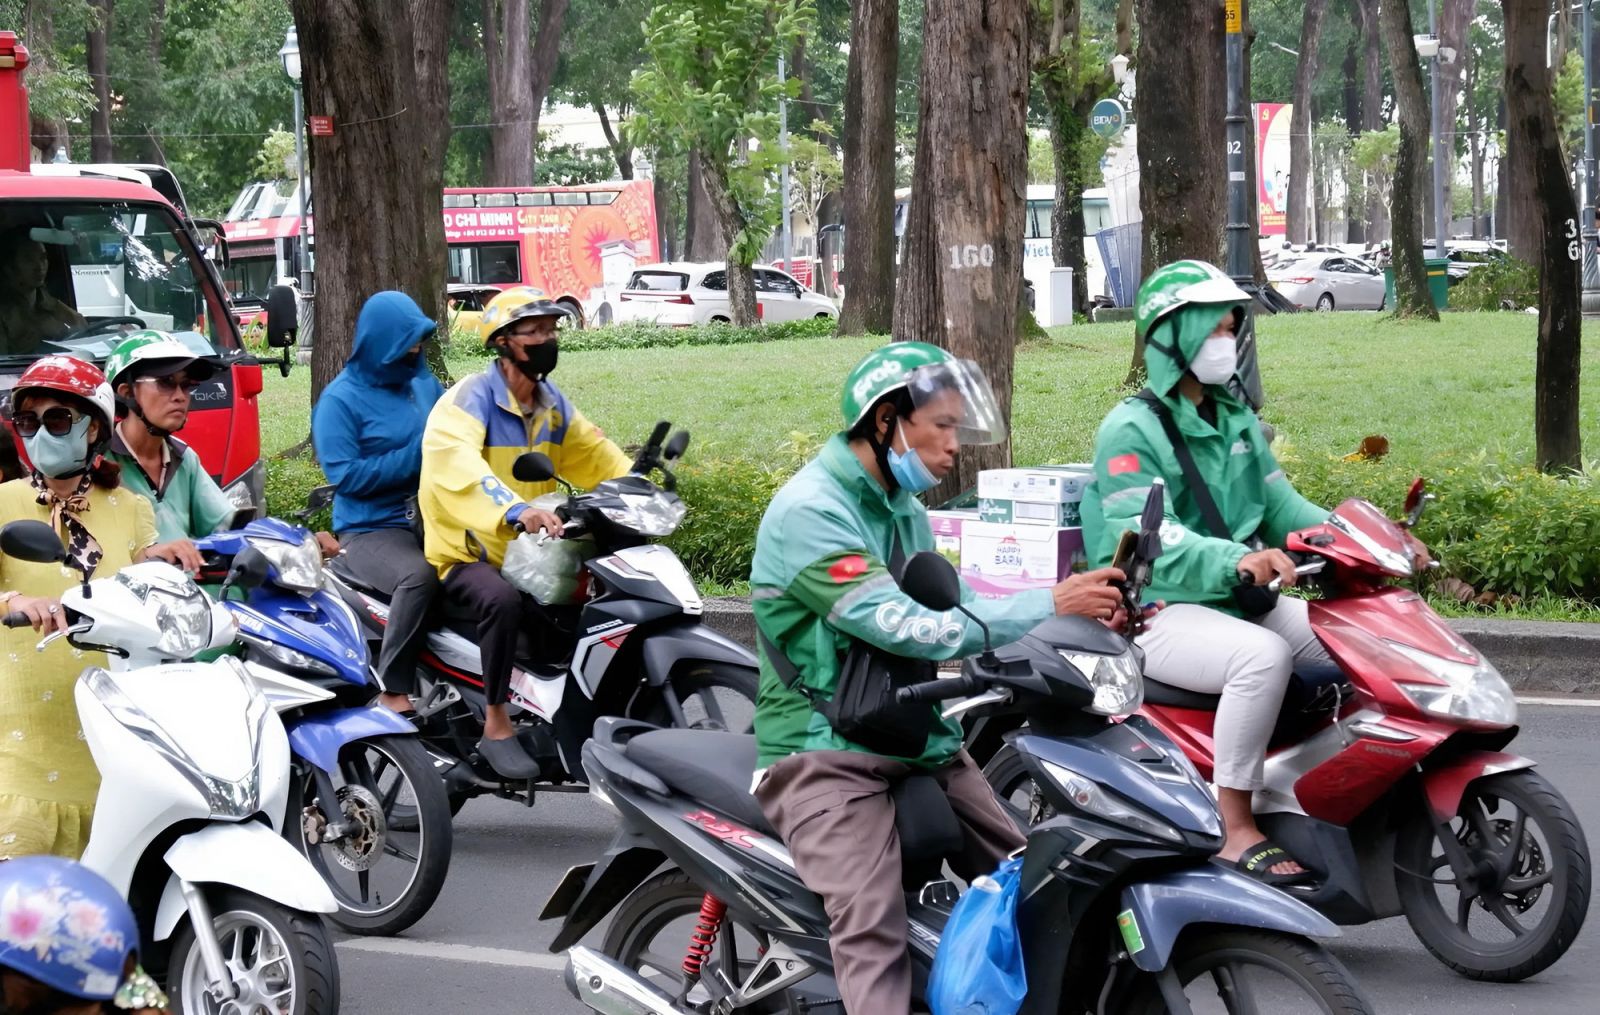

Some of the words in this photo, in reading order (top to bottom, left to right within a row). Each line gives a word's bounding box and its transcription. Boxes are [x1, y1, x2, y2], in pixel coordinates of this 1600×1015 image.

[1094, 115, 1113, 125] BIDV
[455, 213, 478, 227] CHI
[480, 212, 513, 226] MINH
[949, 244, 994, 269] 160
[994, 555, 1023, 567] BARN
[875, 601, 965, 648] Grab
[1365, 744, 1412, 759] HONDA
